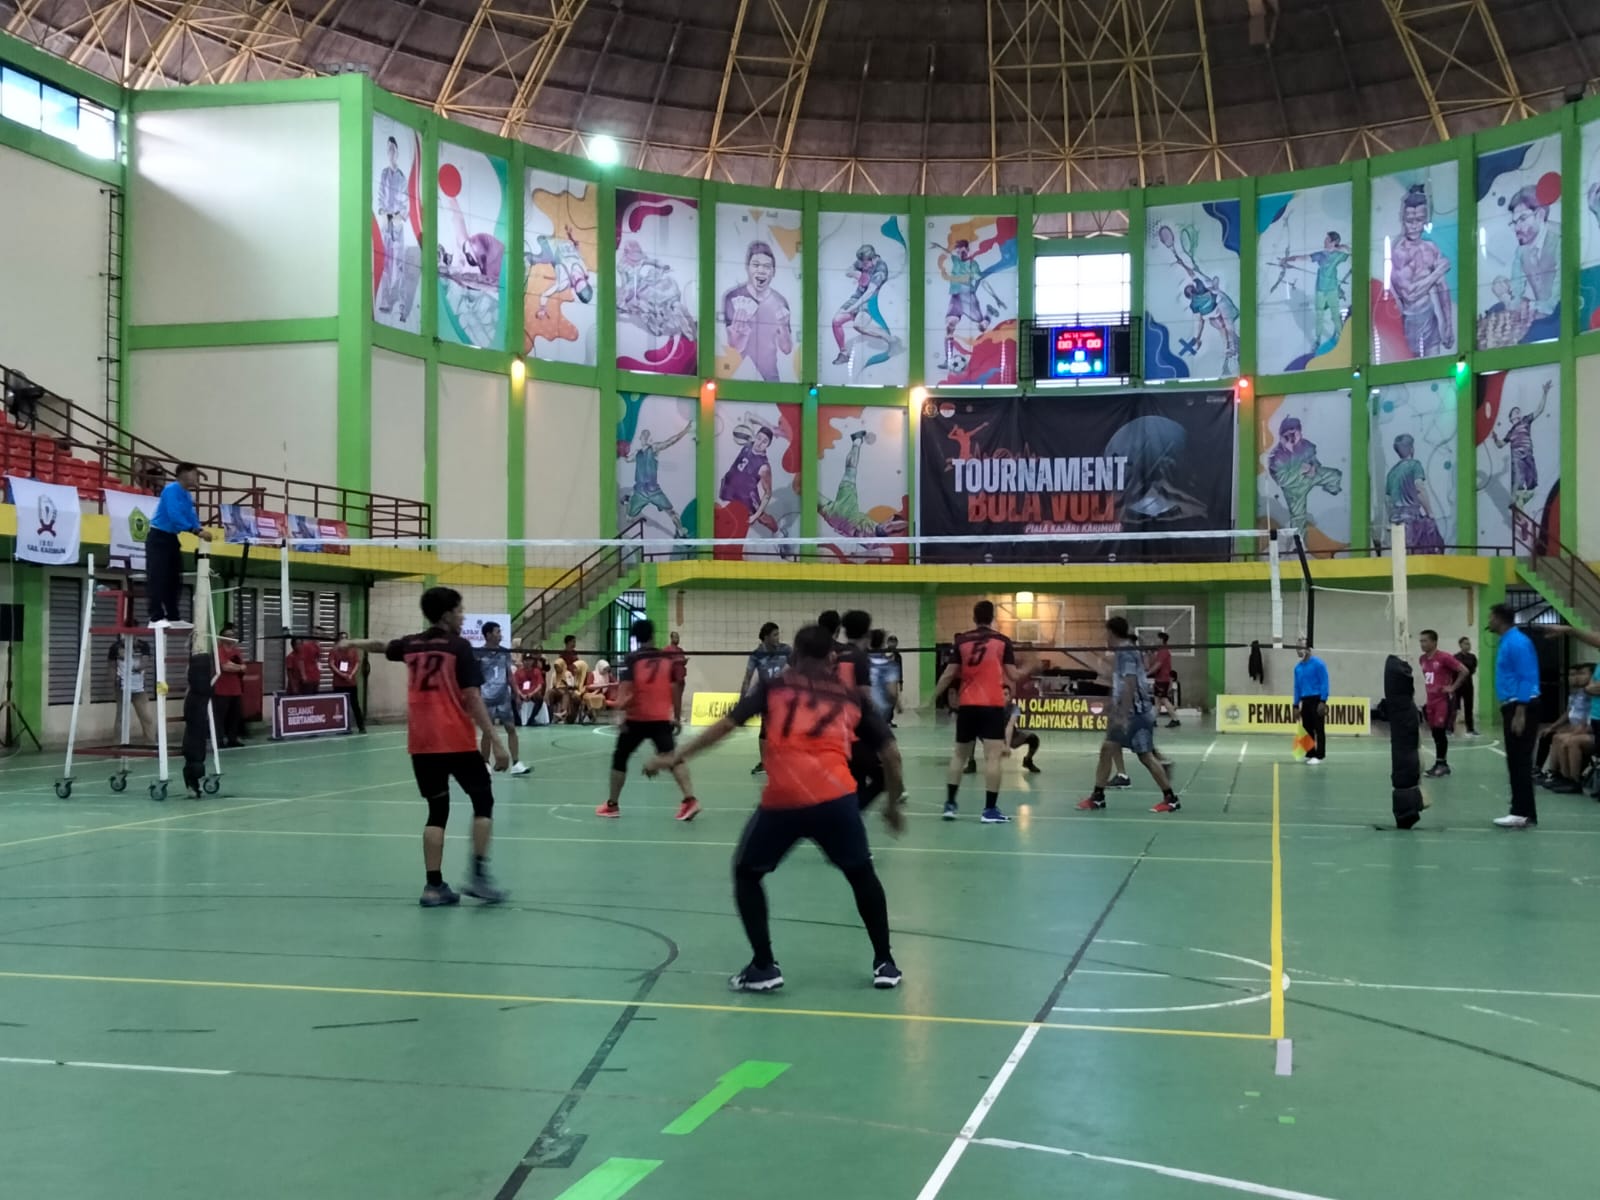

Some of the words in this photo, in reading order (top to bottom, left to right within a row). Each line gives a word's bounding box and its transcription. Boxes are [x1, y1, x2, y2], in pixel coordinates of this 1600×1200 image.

[952, 456, 1128, 492] TOURNAMENT
[968, 641, 987, 667] 5
[407, 655, 442, 690] 12
[492, 665, 499, 679] 1
[287, 705, 315, 716] SELAMAT
[1029, 699, 1089, 713] OLAHRAGA
[1028, 714, 1079, 729] ADHYAKSA
[1082, 715, 1094, 729] KE
[1096, 716, 1108, 729] 63
